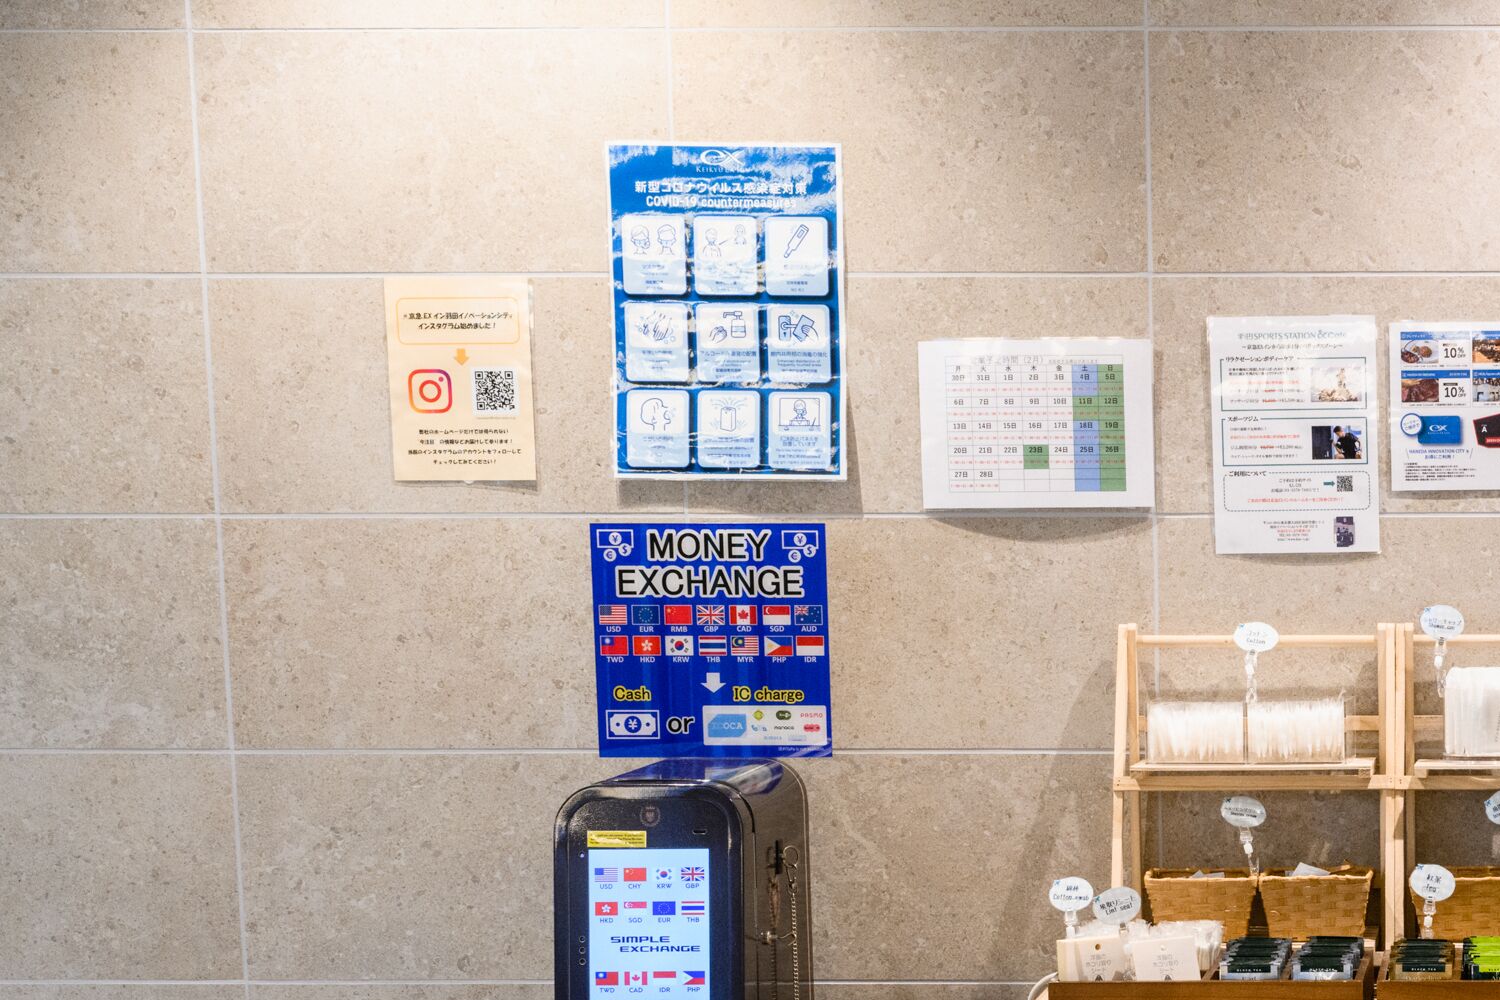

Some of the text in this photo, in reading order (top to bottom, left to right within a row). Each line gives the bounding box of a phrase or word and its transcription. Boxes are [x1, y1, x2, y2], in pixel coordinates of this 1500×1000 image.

[634, 181, 807, 195] 新型コロナウイルス感染症対策
[646, 197, 796, 207] COVID-19 countermeasures
[647, 531, 770, 561] MONEY
[616, 567, 804, 597] EXCHANGE
[613, 687, 651, 702] Cash
[733, 687, 804, 704] IC charge
[667, 716, 694, 734] or
[619, 945, 701, 953] EXCHANGE
